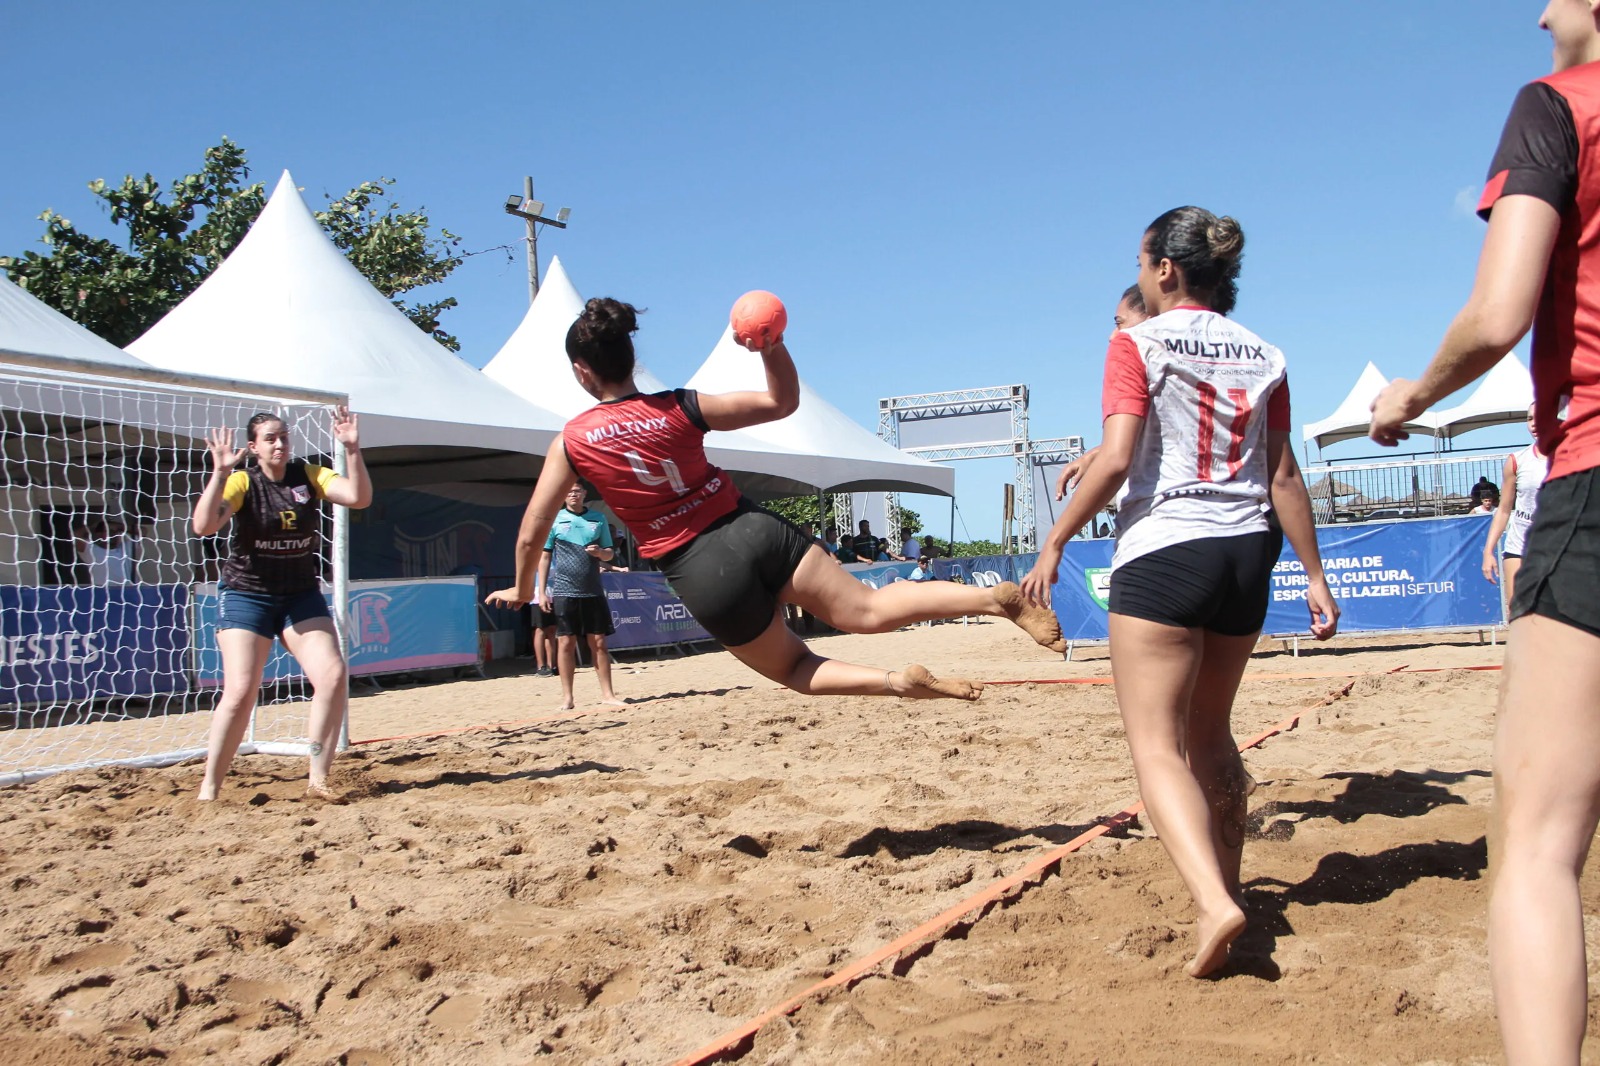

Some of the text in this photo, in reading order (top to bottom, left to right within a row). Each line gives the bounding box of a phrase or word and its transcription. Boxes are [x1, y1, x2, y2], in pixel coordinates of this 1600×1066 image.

[1164, 338, 1266, 361] MULTIVIX
[585, 416, 669, 444] MULTIVIX
[624, 449, 690, 497] 4
[279, 510, 298, 530] 12
[1272, 556, 1383, 573] SECTARIA DE
[1272, 569, 1415, 587] TURIO, CULTURA,
[1273, 581, 1455, 602] ESPOE E LAZER SETUR
[656, 603, 693, 620] AREN
[0, 633, 100, 667] ESTES
